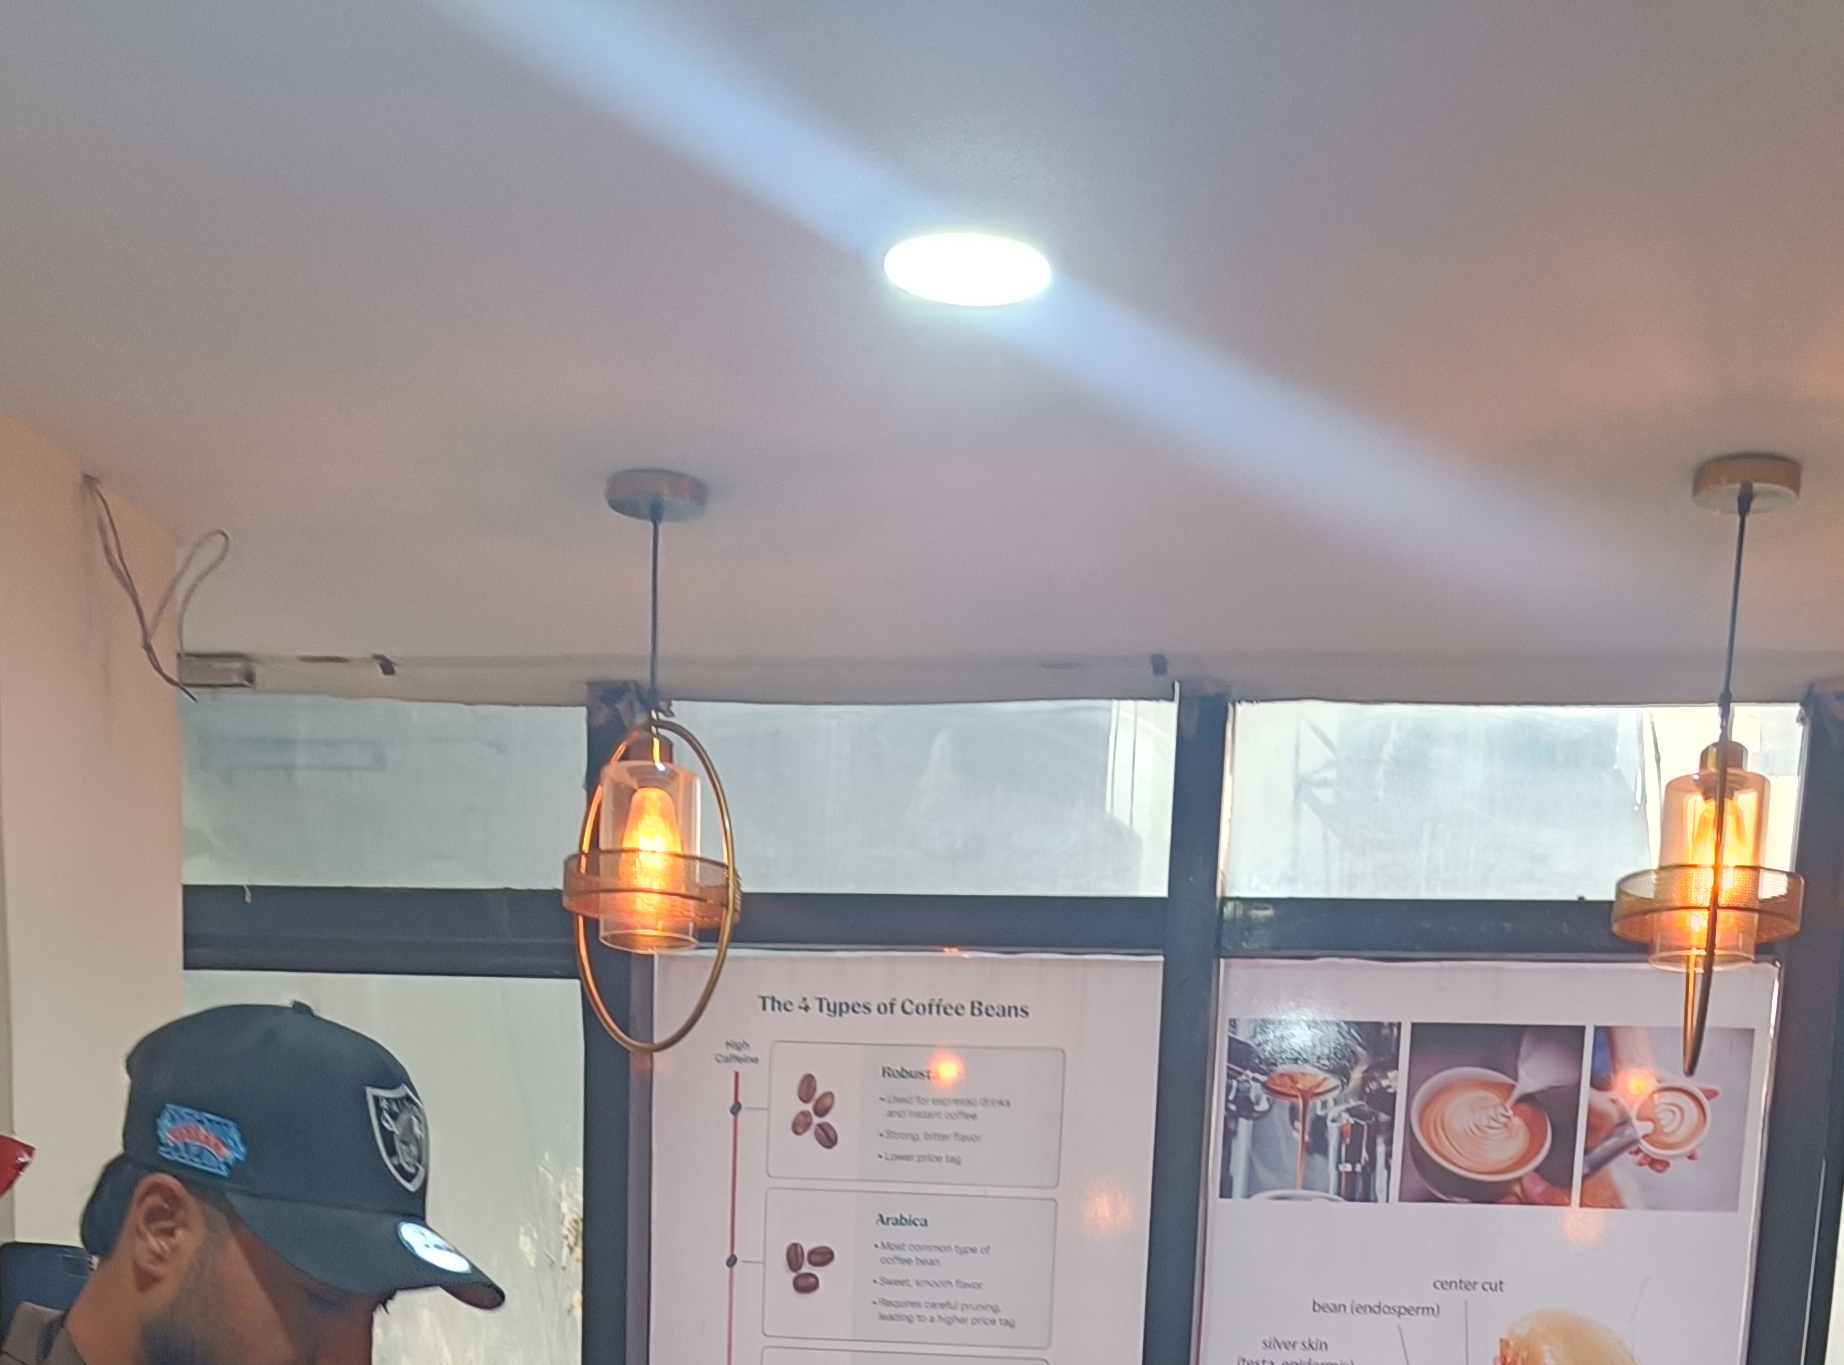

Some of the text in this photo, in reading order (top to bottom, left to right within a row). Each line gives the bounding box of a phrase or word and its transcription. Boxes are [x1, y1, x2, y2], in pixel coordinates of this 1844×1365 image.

[758, 995, 1030, 1019] The 4 Types of Coffee Beans
[876, 1213, 929, 1227] Arabica
[1433, 1278, 1505, 1293] center cut
[1312, 1299, 1440, 1319] bean (endosperm)
[1261, 1337, 1328, 1352] silver skin
